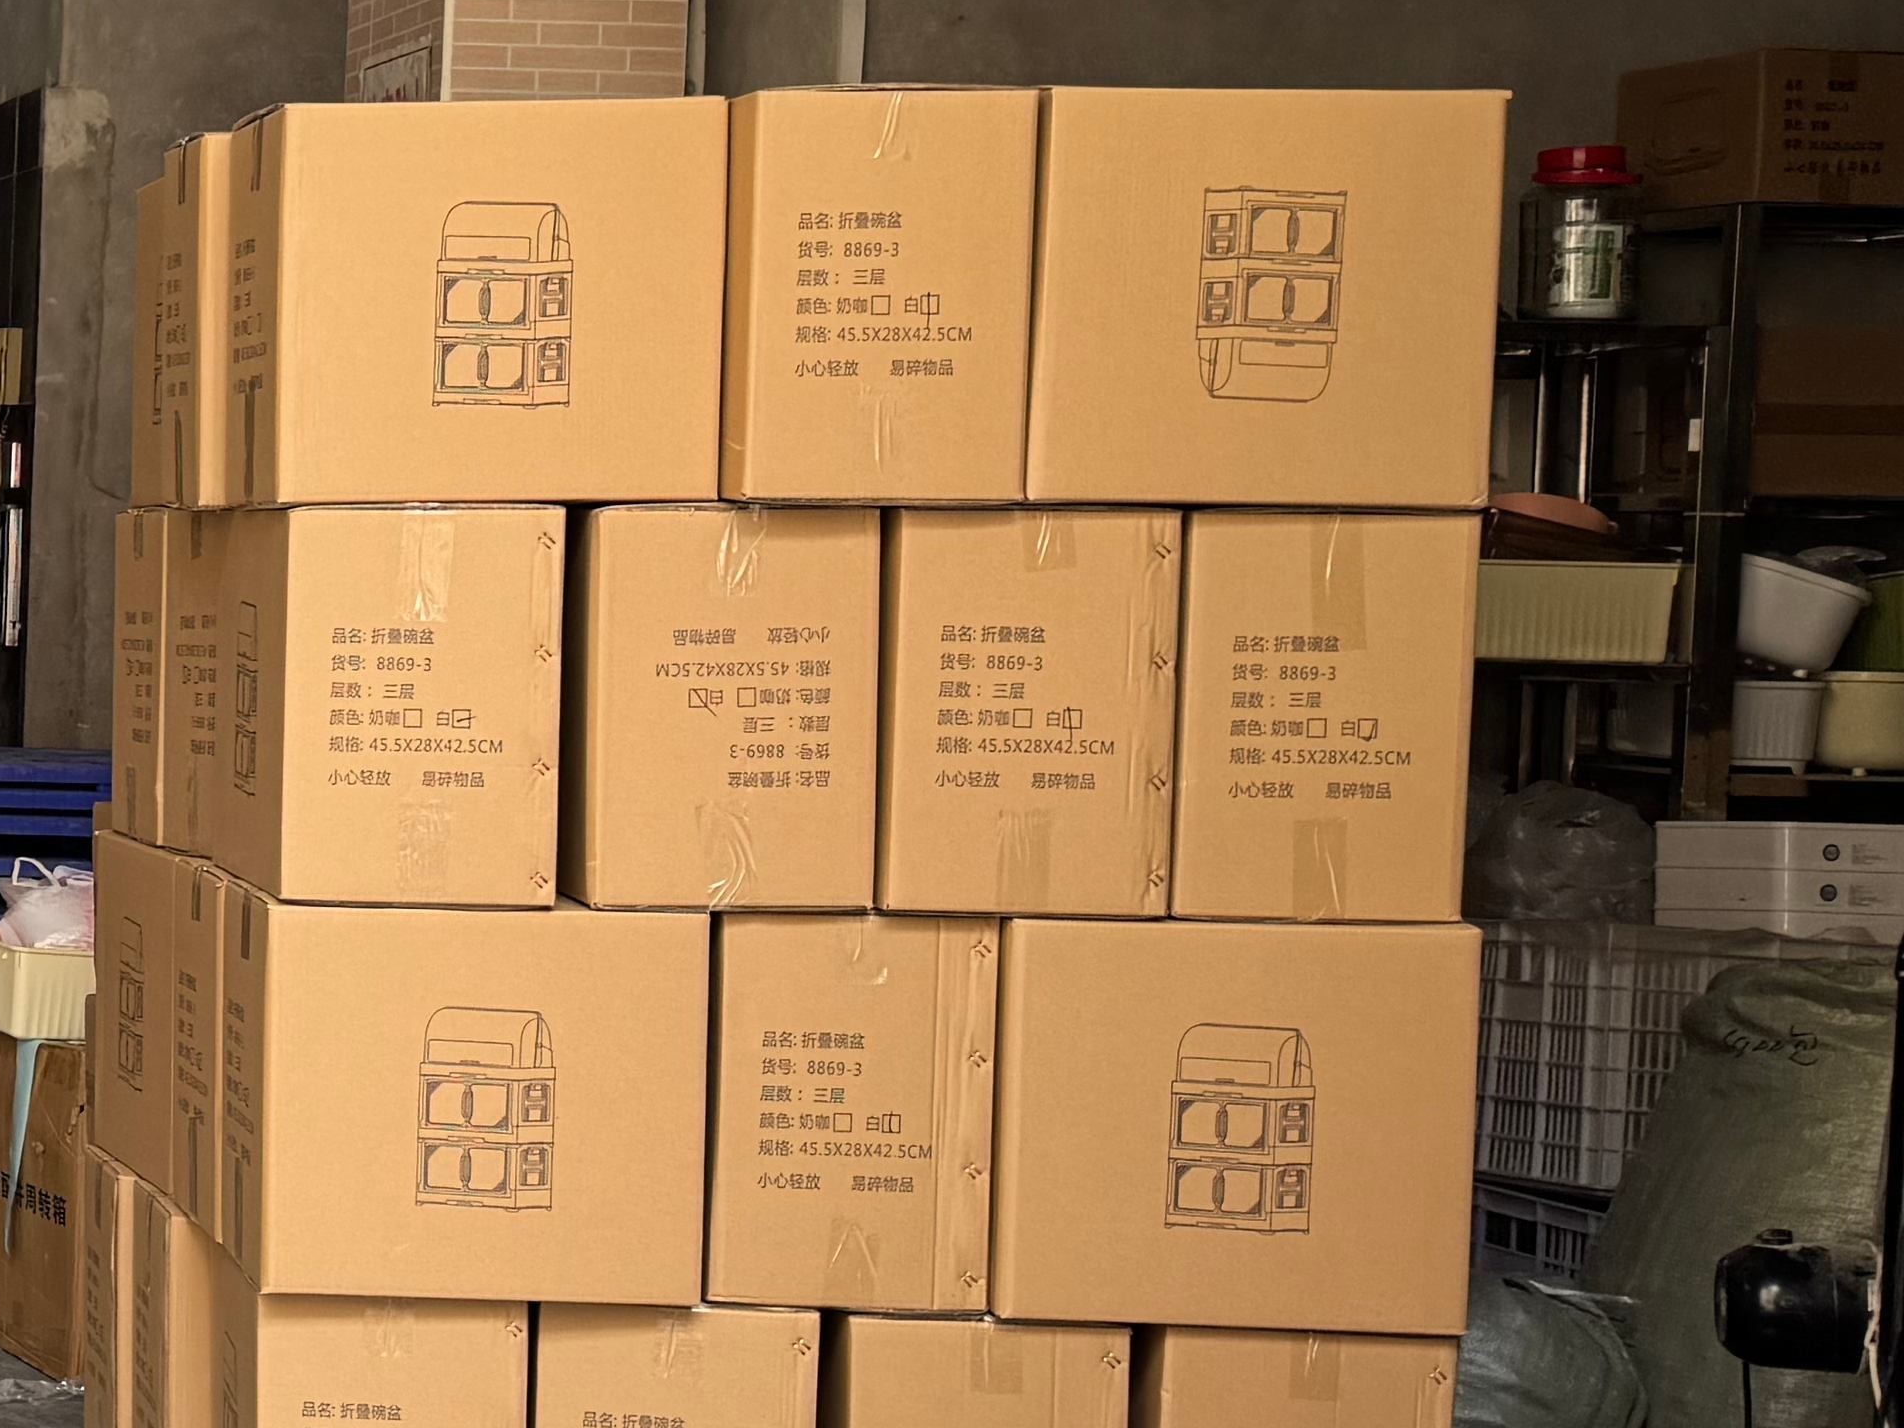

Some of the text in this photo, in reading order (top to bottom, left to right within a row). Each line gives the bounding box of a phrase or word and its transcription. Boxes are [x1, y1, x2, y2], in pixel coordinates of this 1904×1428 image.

[844, 242, 899, 257] 8869-3
[852, 269, 884, 286] 三层
[836, 297, 867, 314] 奶咖
[904, 296, 918, 313] 白
[837, 326, 971, 341] 45.5X28X42.5CM
[795, 359, 953, 377] 小心轻放 易碎物品
[377, 656, 431, 672] 8869-3
[1280, 665, 1336, 680] 8869-3
[383, 683, 414, 699] 三层
[1288, 693, 1320, 709] 三层
[368, 709, 399, 725] 奶咖
[436, 710, 450, 726] 白
[1271, 720, 1303, 736] 奶咖
[1341, 720, 1355, 737] 白
[370, 737, 502, 753] 45.5X28X42.5CM
[1272, 749, 1410, 764] 45.5X28X42.5CM
[328, 769, 484, 787] 小心轻放 易碎物品
[1229, 781, 1391, 799] 小心轻放 易碎物品
